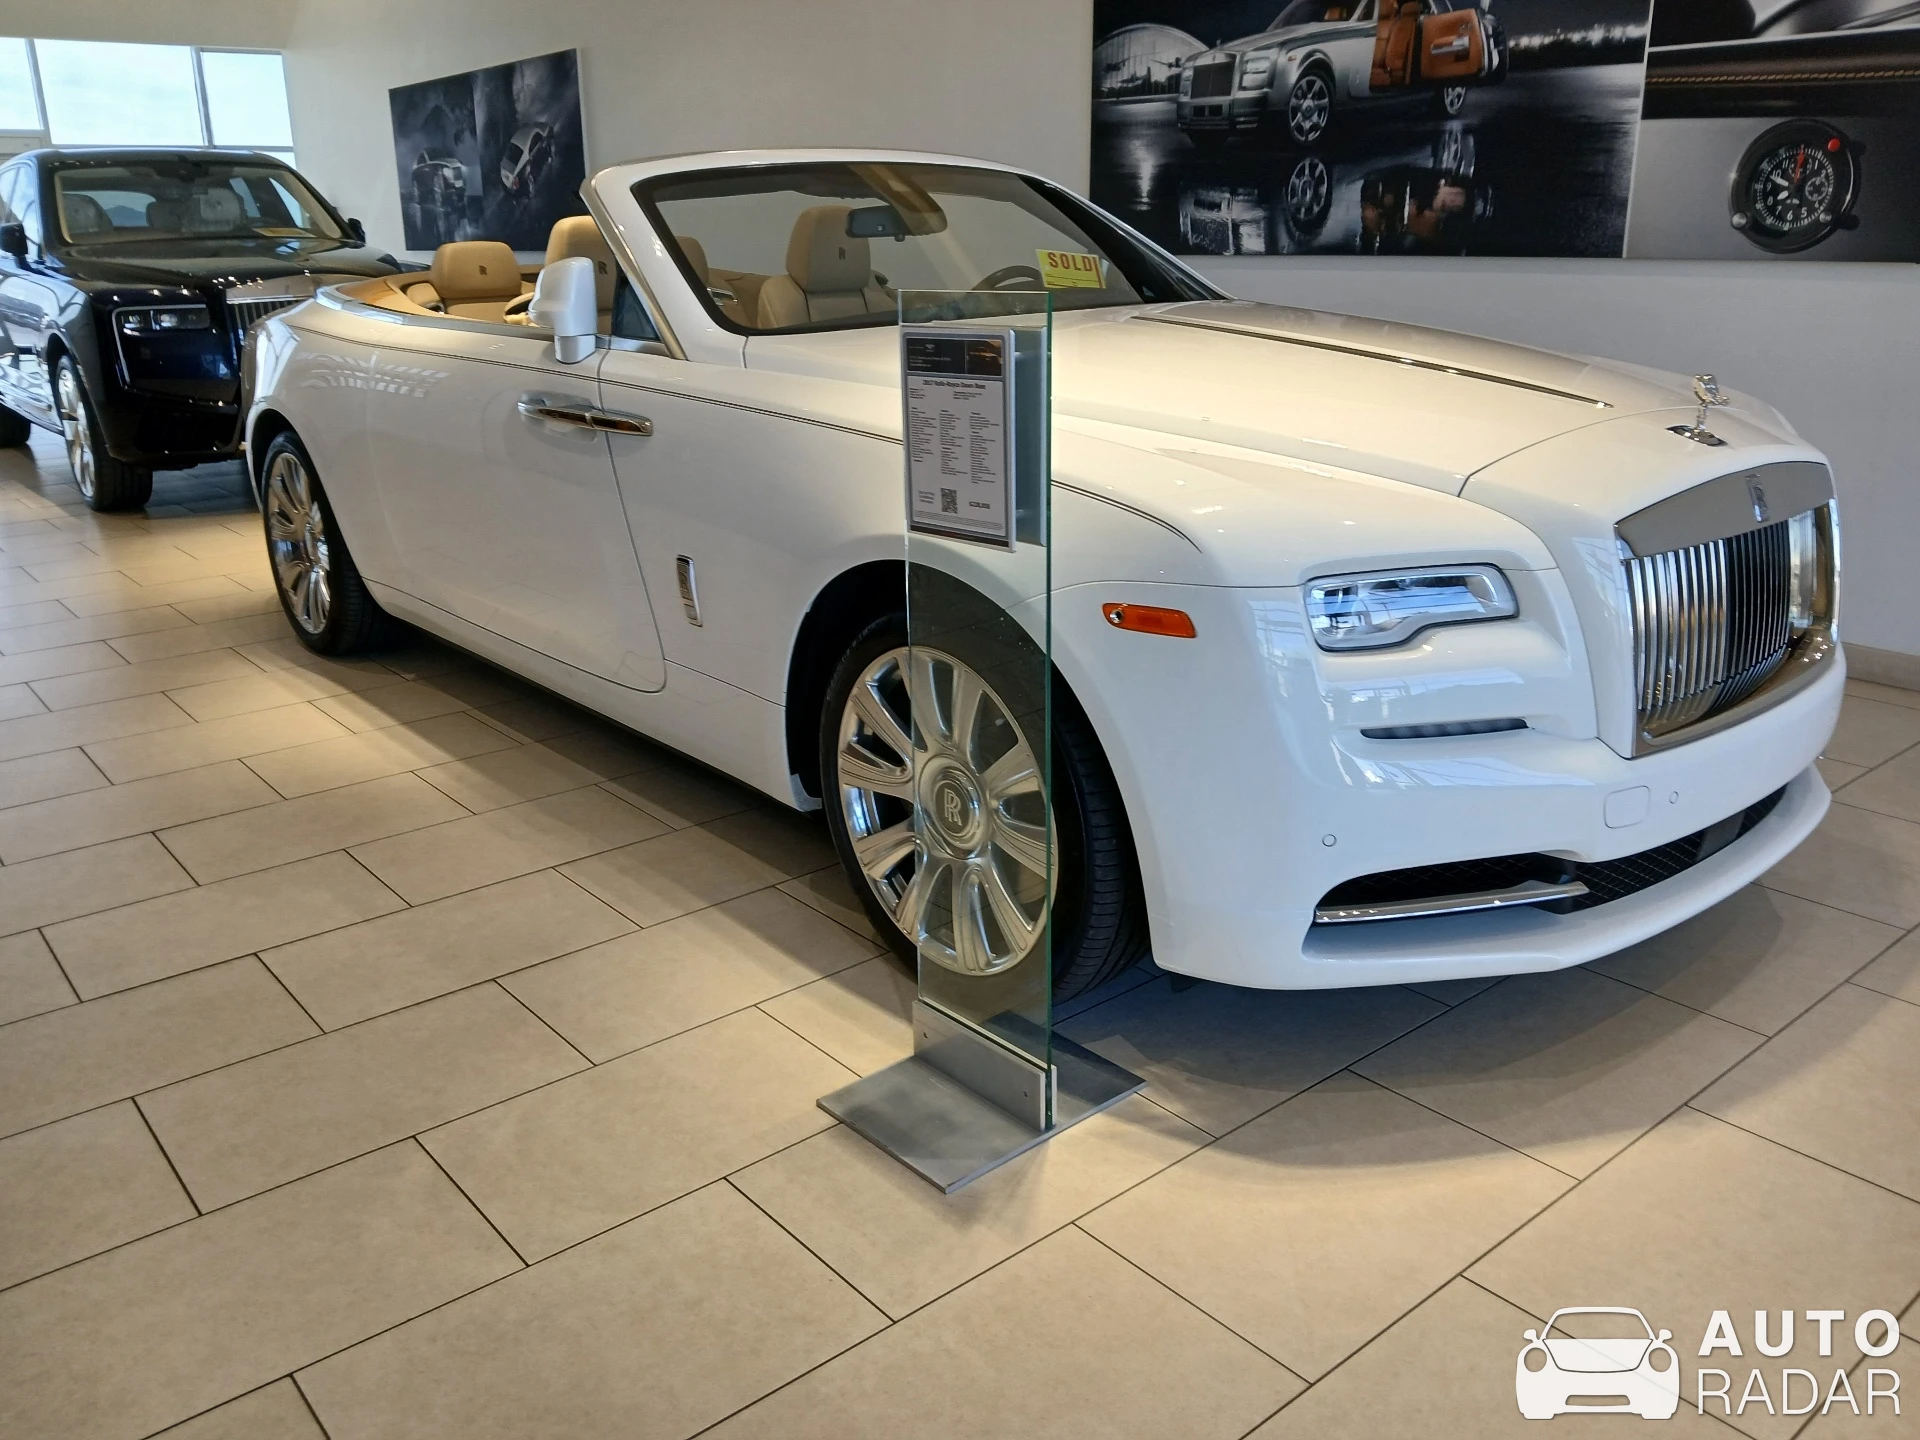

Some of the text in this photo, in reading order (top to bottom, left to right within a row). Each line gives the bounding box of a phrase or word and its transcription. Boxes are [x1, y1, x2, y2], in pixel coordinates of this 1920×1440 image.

[1766, 182, 1772, 192] 9
[1767, 196, 1773, 206] 8
[1776, 205, 1783, 216] 7
[1787, 210, 1793, 221] 6
[1801, 207, 1808, 218] 5
